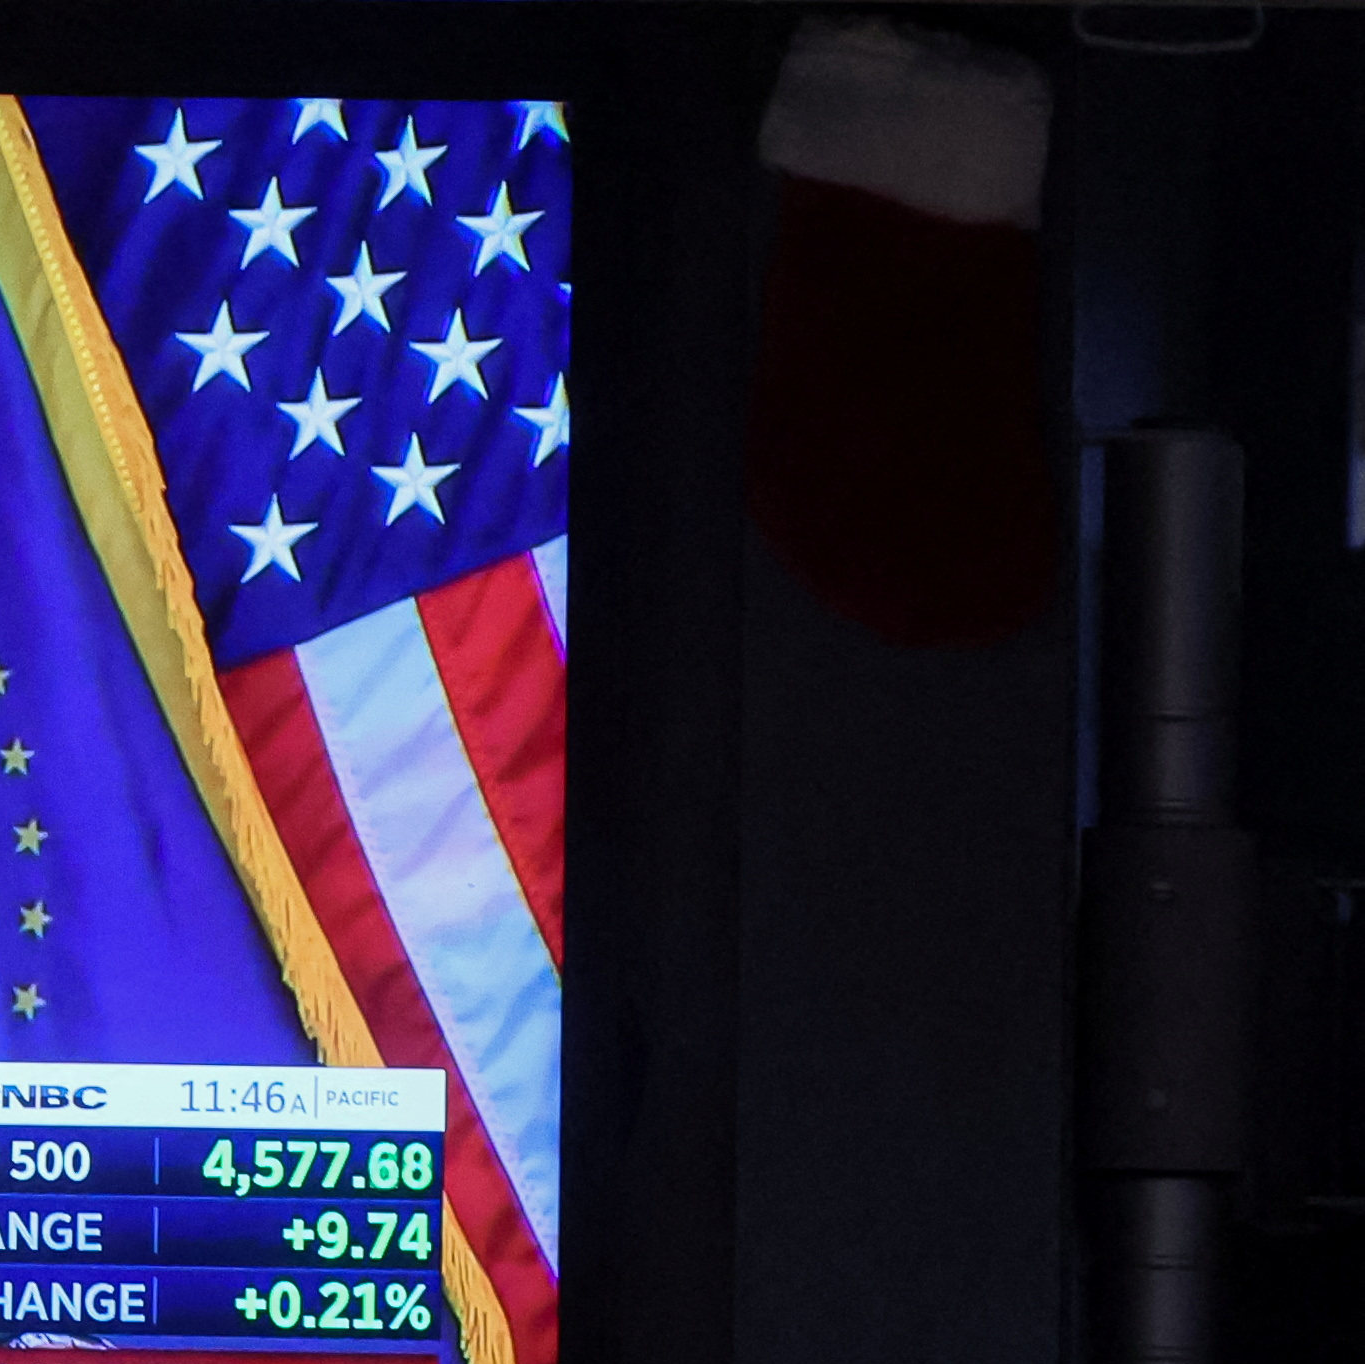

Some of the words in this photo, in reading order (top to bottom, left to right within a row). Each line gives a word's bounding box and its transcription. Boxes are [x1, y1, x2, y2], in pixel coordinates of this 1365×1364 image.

[326, 1090, 400, 1107] PACIFIC
[10, 1141, 91, 1181] 500
[202, 1139, 433, 1196] 4,577.68
[282, 1212, 431, 1260] +9.74
[234, 1282, 431, 1330] +0.21%
